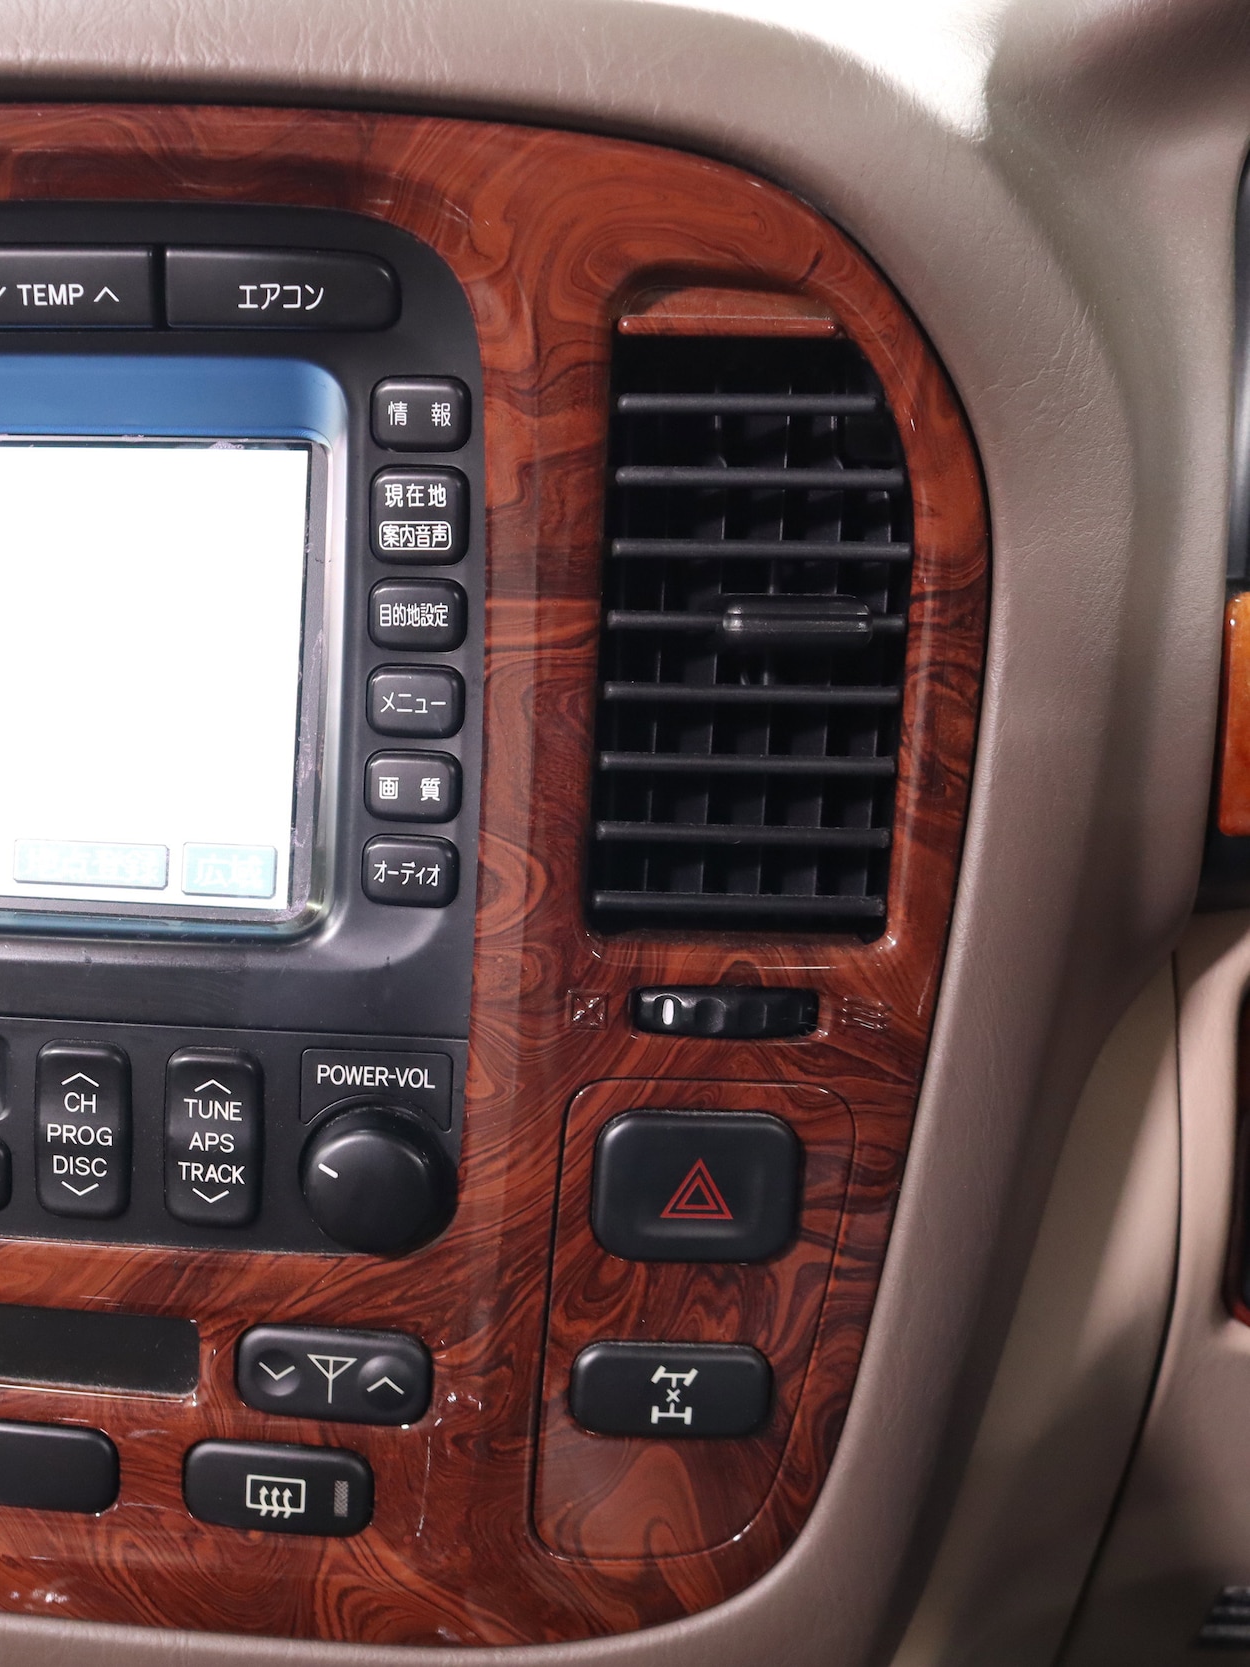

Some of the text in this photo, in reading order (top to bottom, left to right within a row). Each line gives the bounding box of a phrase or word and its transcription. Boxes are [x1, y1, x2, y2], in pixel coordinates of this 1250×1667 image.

[16, 283, 84, 307] TEMP
[237, 283, 325, 311] エアコン
[387, 401, 452, 427] 情報
[384, 483, 448, 508] 現在地
[382, 524, 449, 548] 案内音声
[379, 603, 449, 628] 目的地設定
[380, 692, 447, 714] メニュー
[378, 776, 442, 802] 画質
[373, 860, 441, 887] オーディオ
[316, 1063, 436, 1089] POWER-VOL
[63, 1092, 97, 1113] CH
[183, 1097, 243, 1122] TUNE
[46, 1123, 113, 1147] PROG
[188, 1131, 235, 1153] APS
[52, 1155, 108, 1178] DISC
[177, 1160, 245, 1185] TRACK
